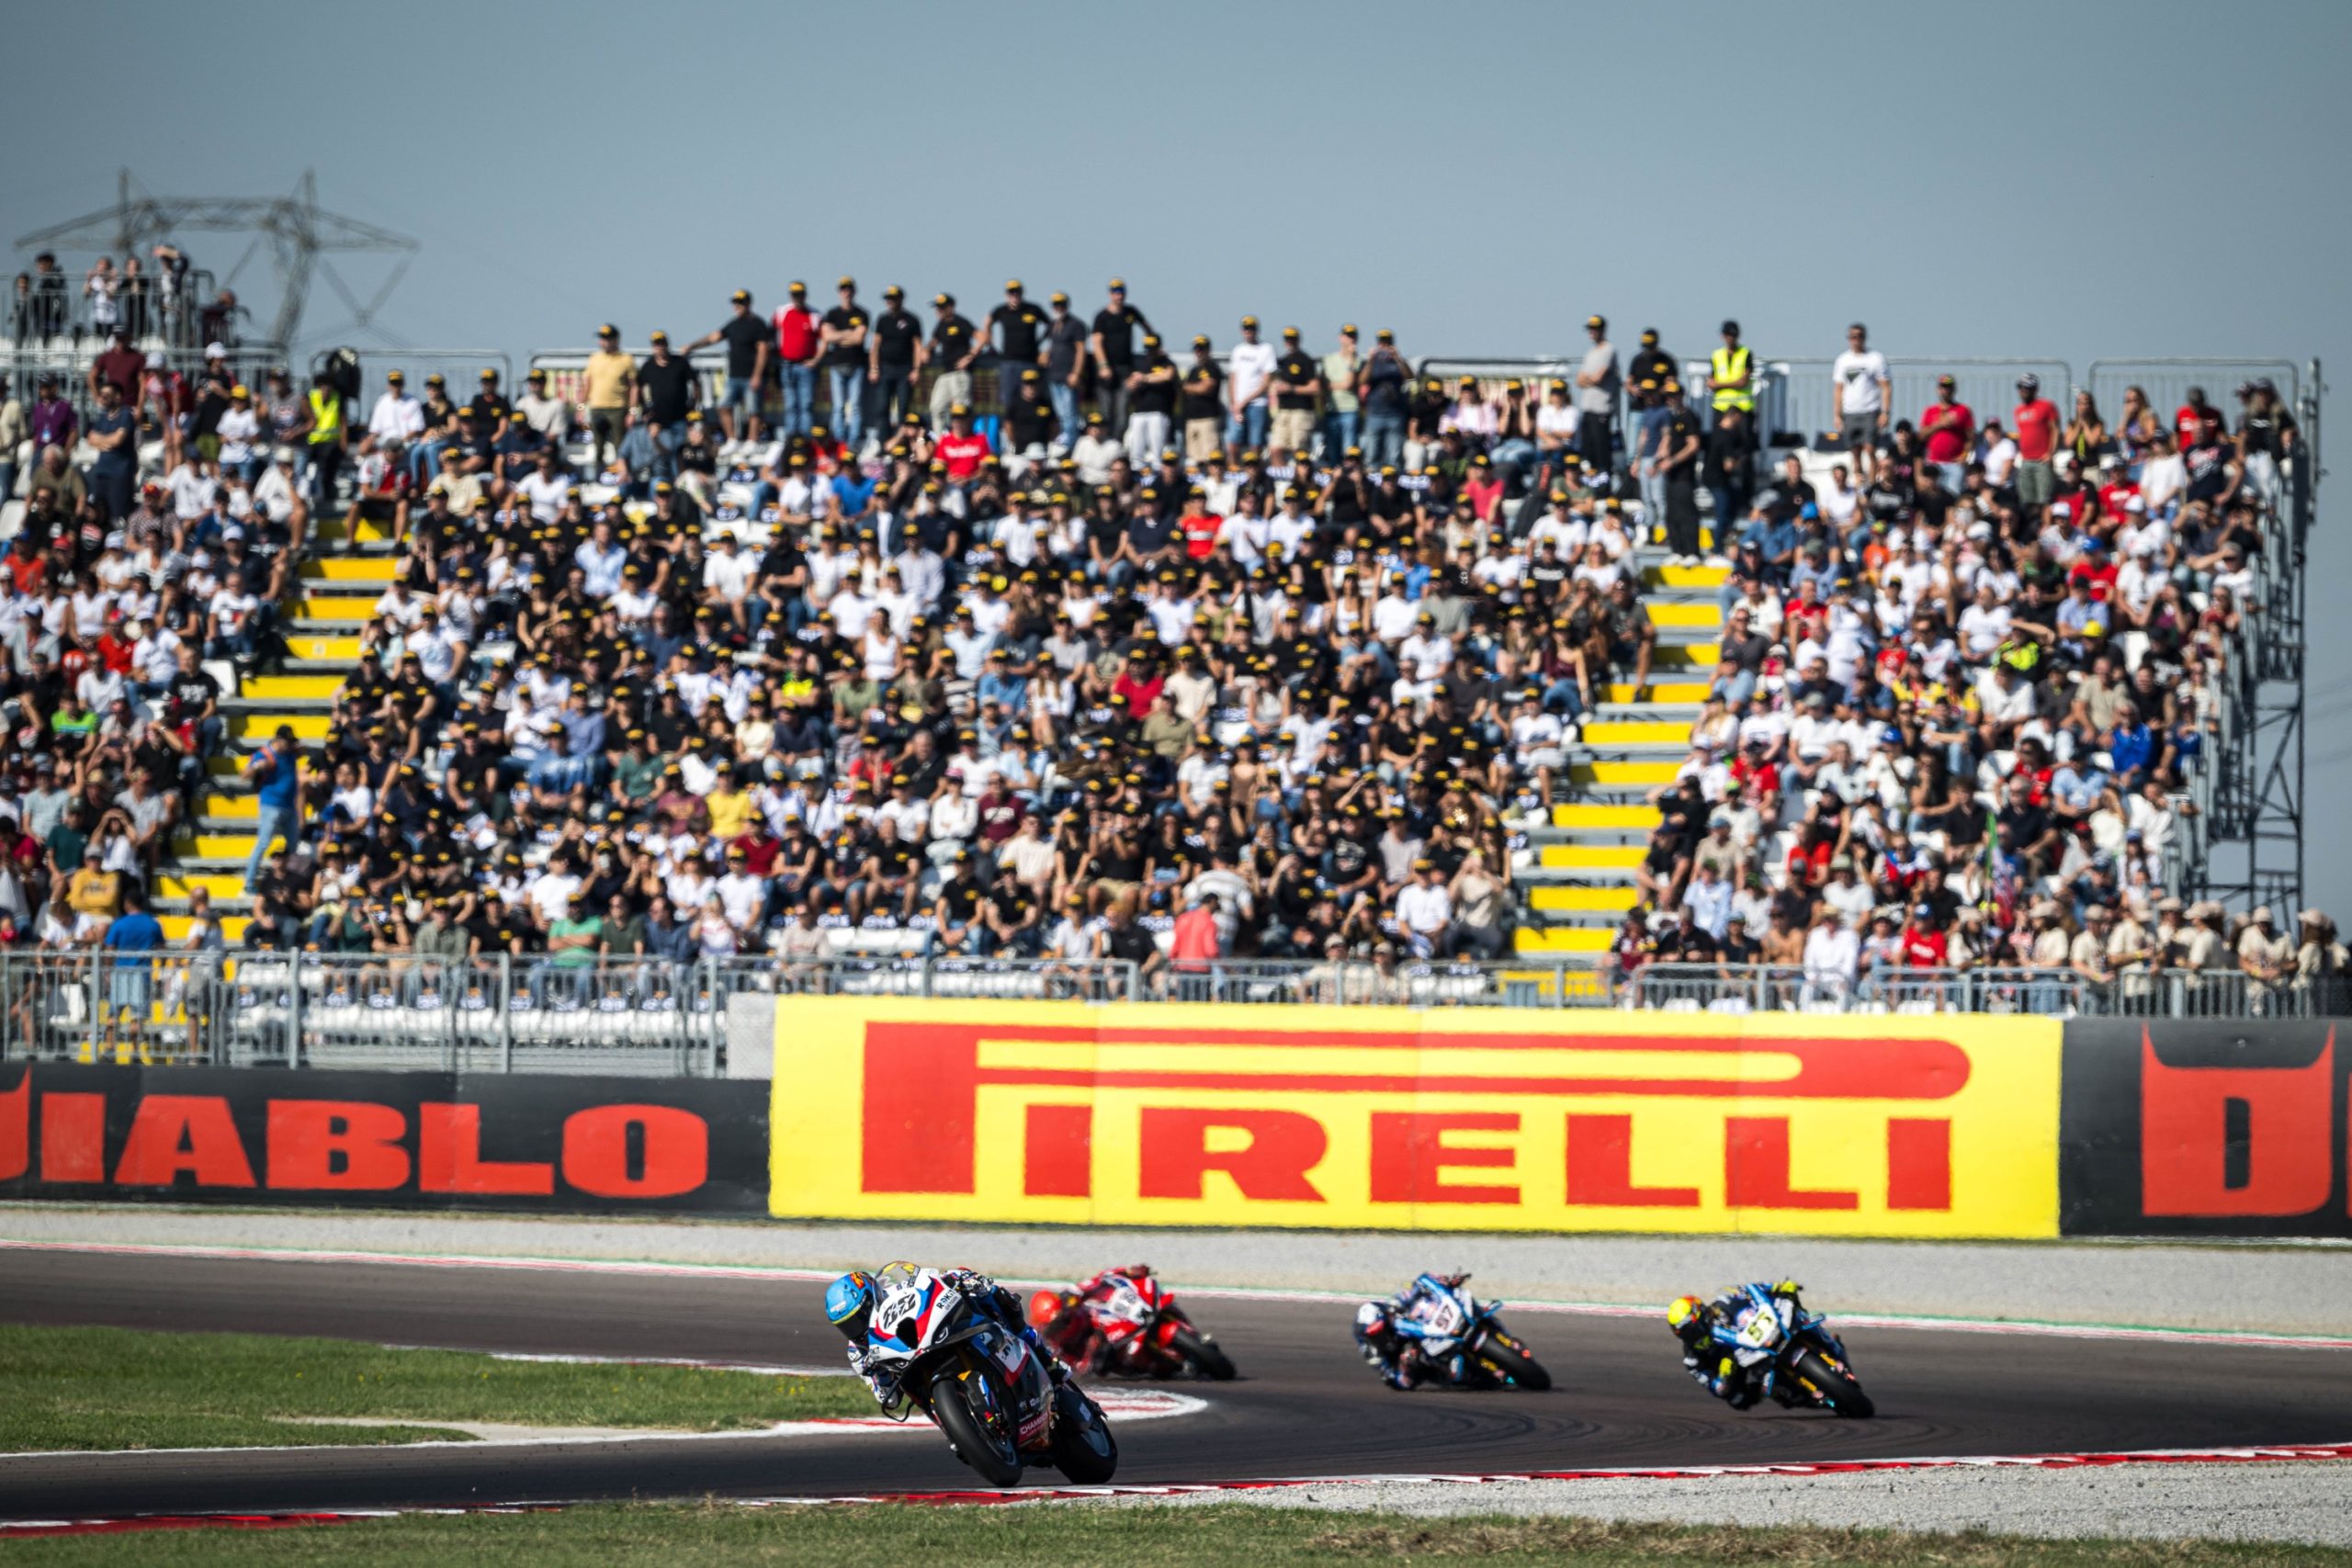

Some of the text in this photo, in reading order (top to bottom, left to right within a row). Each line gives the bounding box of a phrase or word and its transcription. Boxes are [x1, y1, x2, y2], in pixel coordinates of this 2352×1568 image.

[0, 1066, 708, 1199] IABLO
[861, 1020, 1971, 1212] PIRELLI
[2142, 1021, 2352, 1217] D
